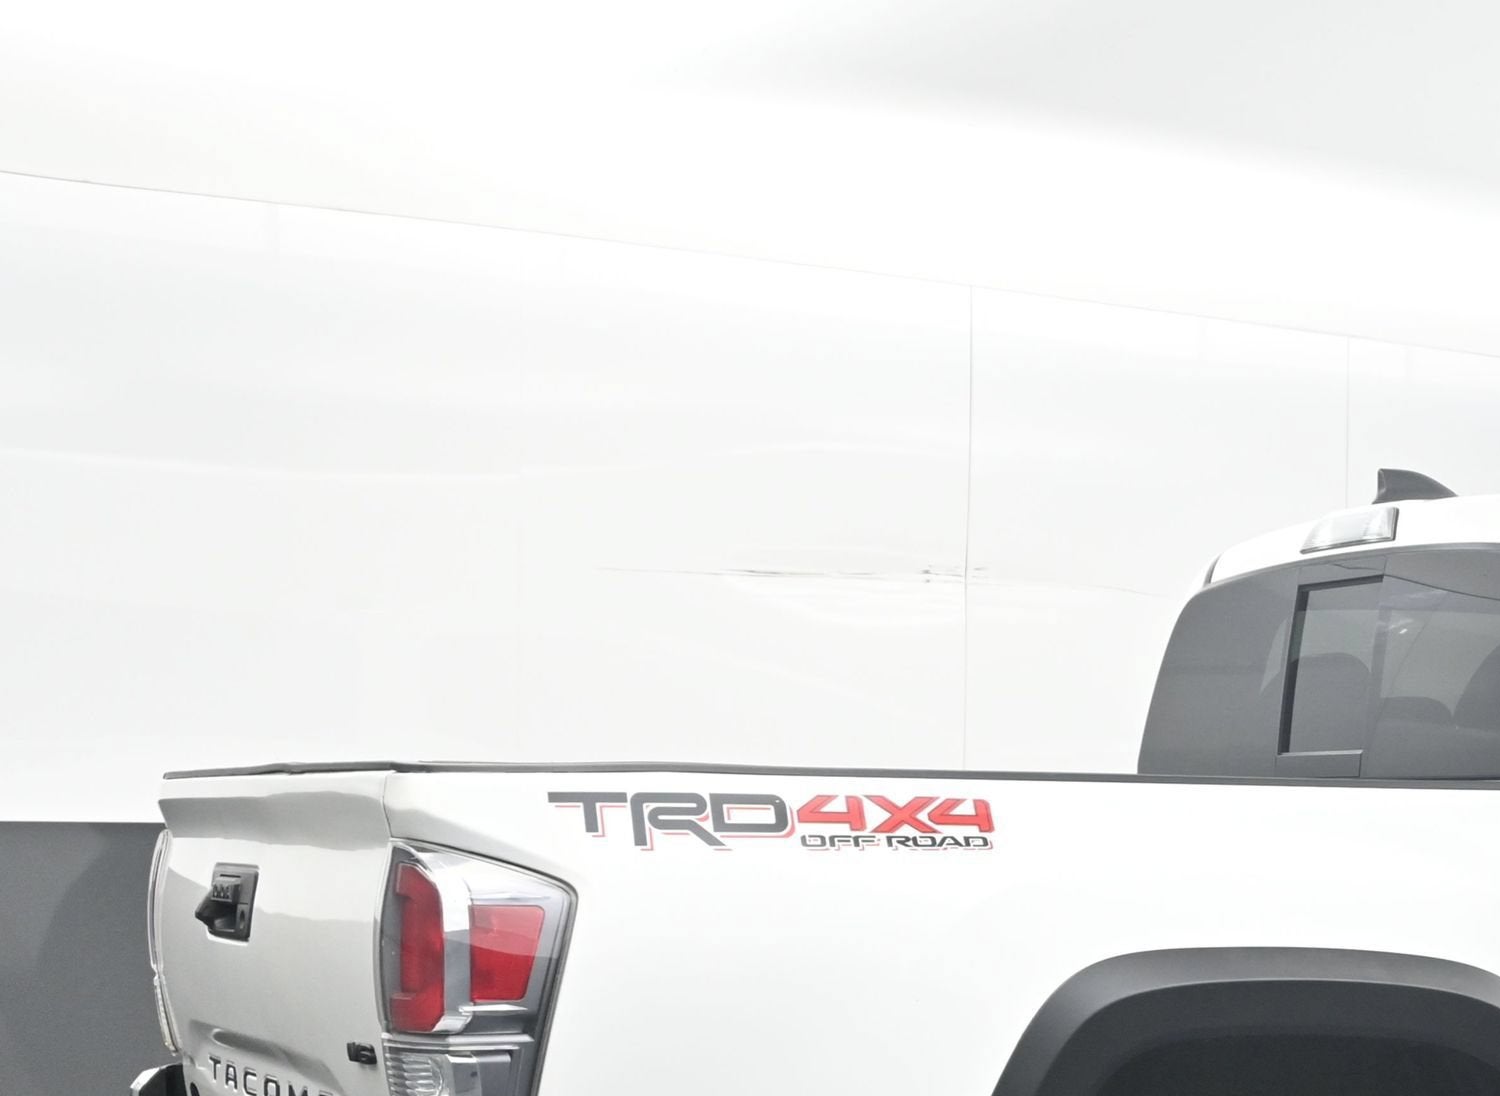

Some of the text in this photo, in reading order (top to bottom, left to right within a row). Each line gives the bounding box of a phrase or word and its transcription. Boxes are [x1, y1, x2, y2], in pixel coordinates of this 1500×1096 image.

[547, 791, 796, 851] TRD
[800, 834, 994, 851] OFF ROAD
